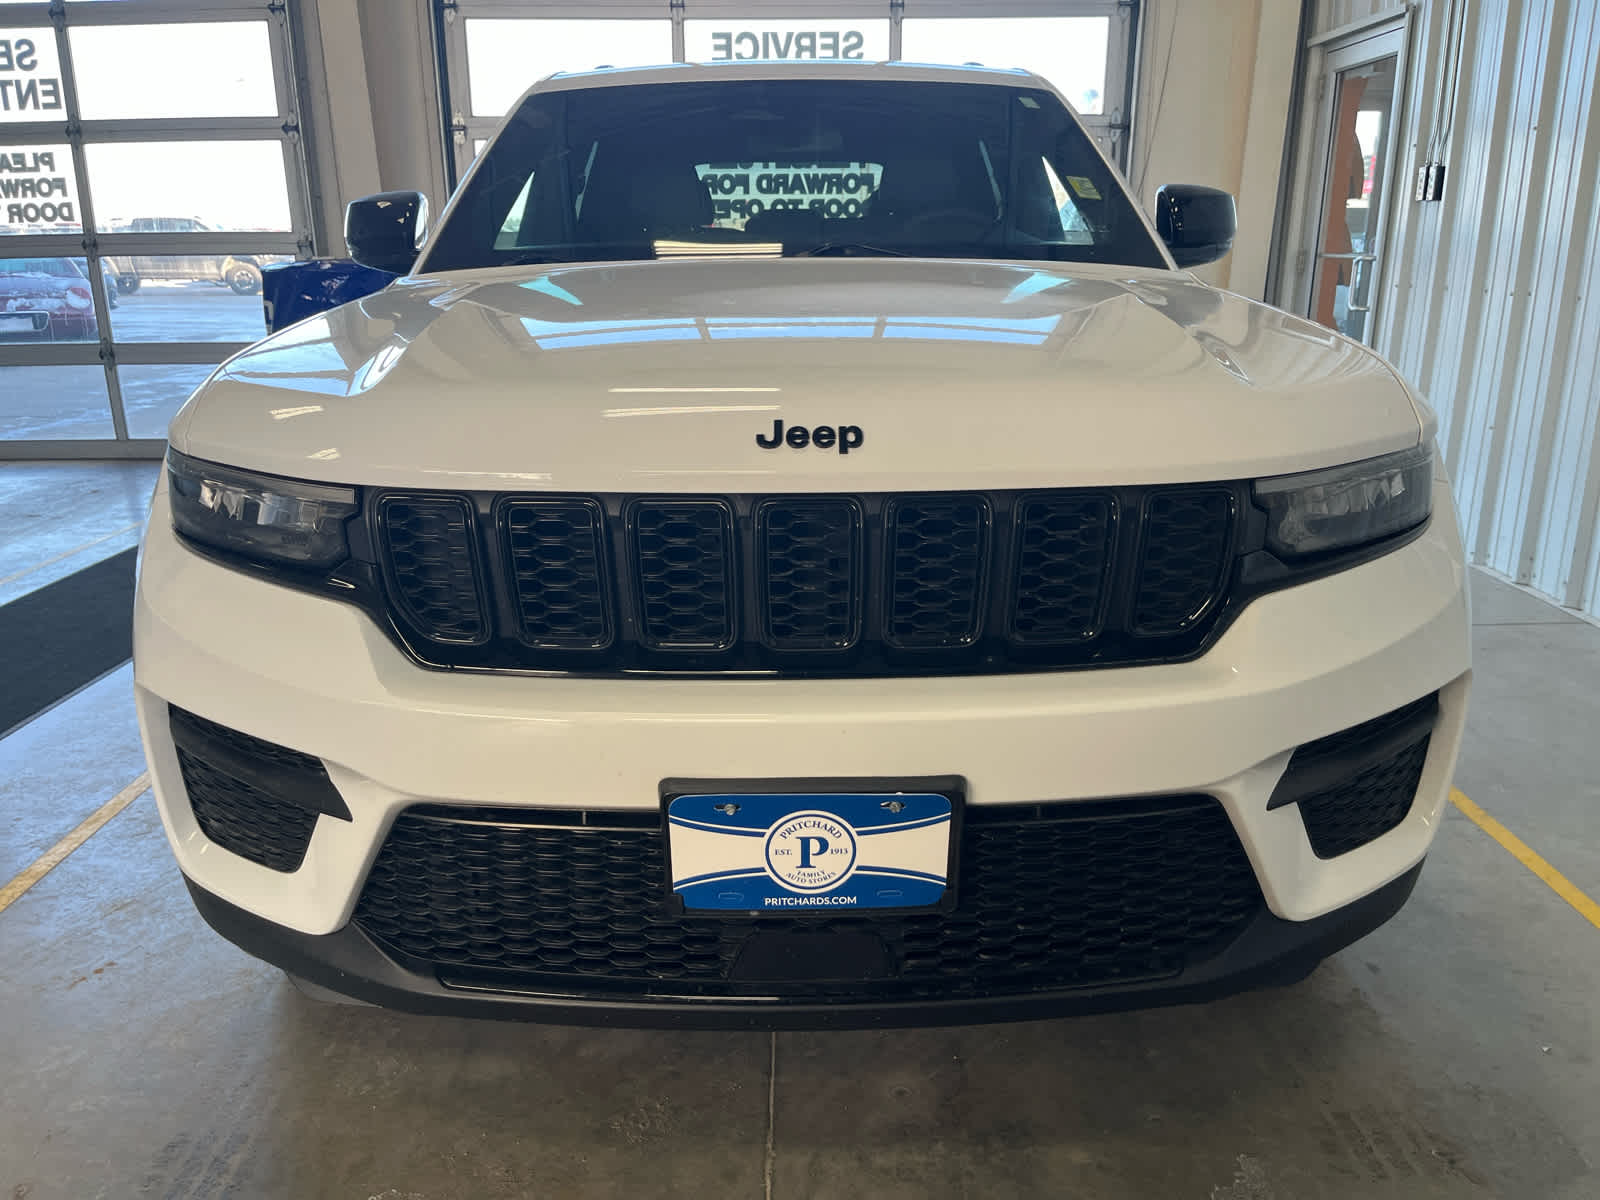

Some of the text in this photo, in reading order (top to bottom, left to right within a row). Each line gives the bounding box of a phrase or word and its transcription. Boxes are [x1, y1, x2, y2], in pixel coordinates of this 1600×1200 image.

[756, 419, 864, 455] Jeep
[780, 820, 842, 840] PRITCHARD
[795, 836, 829, 869] P
[830, 847, 848, 855] 1913
[786, 872, 836, 884] AUTO STORES
[796, 870, 826, 879] FAMILY
[764, 896, 857, 906] PRITCHARDS.COM
